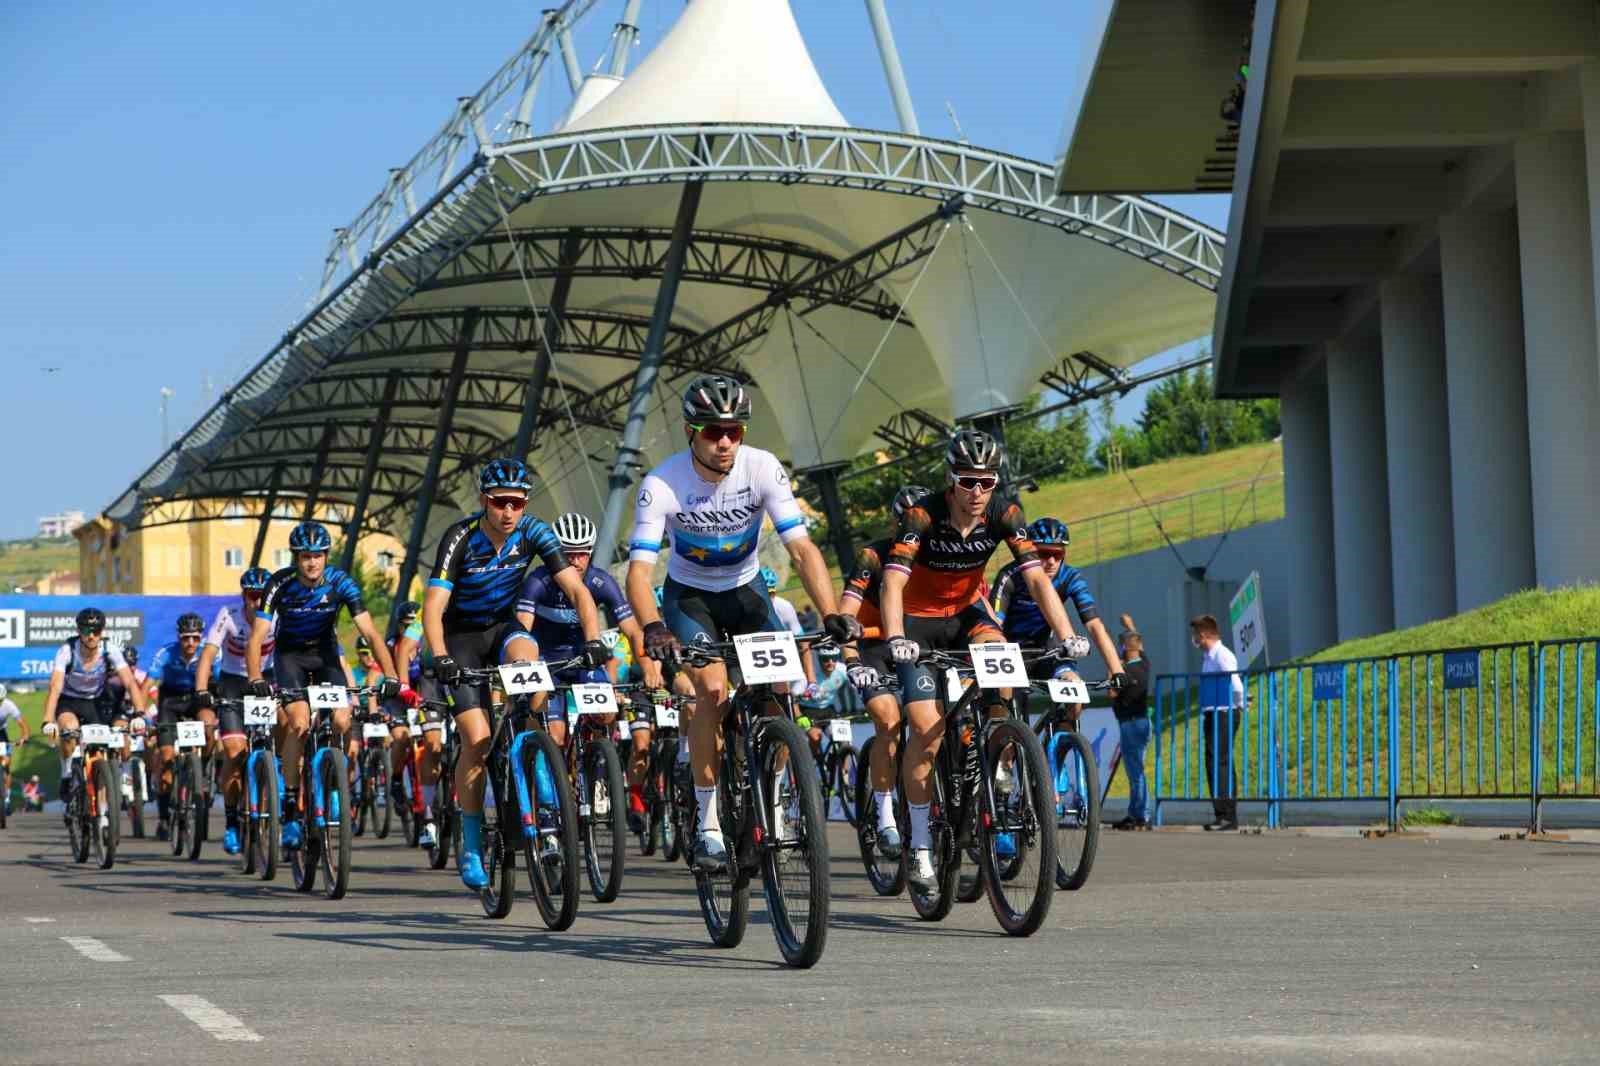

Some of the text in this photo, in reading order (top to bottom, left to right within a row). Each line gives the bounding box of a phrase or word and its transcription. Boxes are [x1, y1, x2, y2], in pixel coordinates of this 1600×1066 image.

[676, 498, 764, 523] CANYON
[929, 539, 996, 553] CANYON
[751, 649, 787, 668] 55
[984, 658, 1015, 674] 56
[511, 671, 543, 685] 44
[317, 692, 339, 702] 43
[1060, 686, 1079, 697] 41
[582, 693, 608, 704] 50
[251, 706, 271, 718] 42
[184, 730, 200, 739] 23
